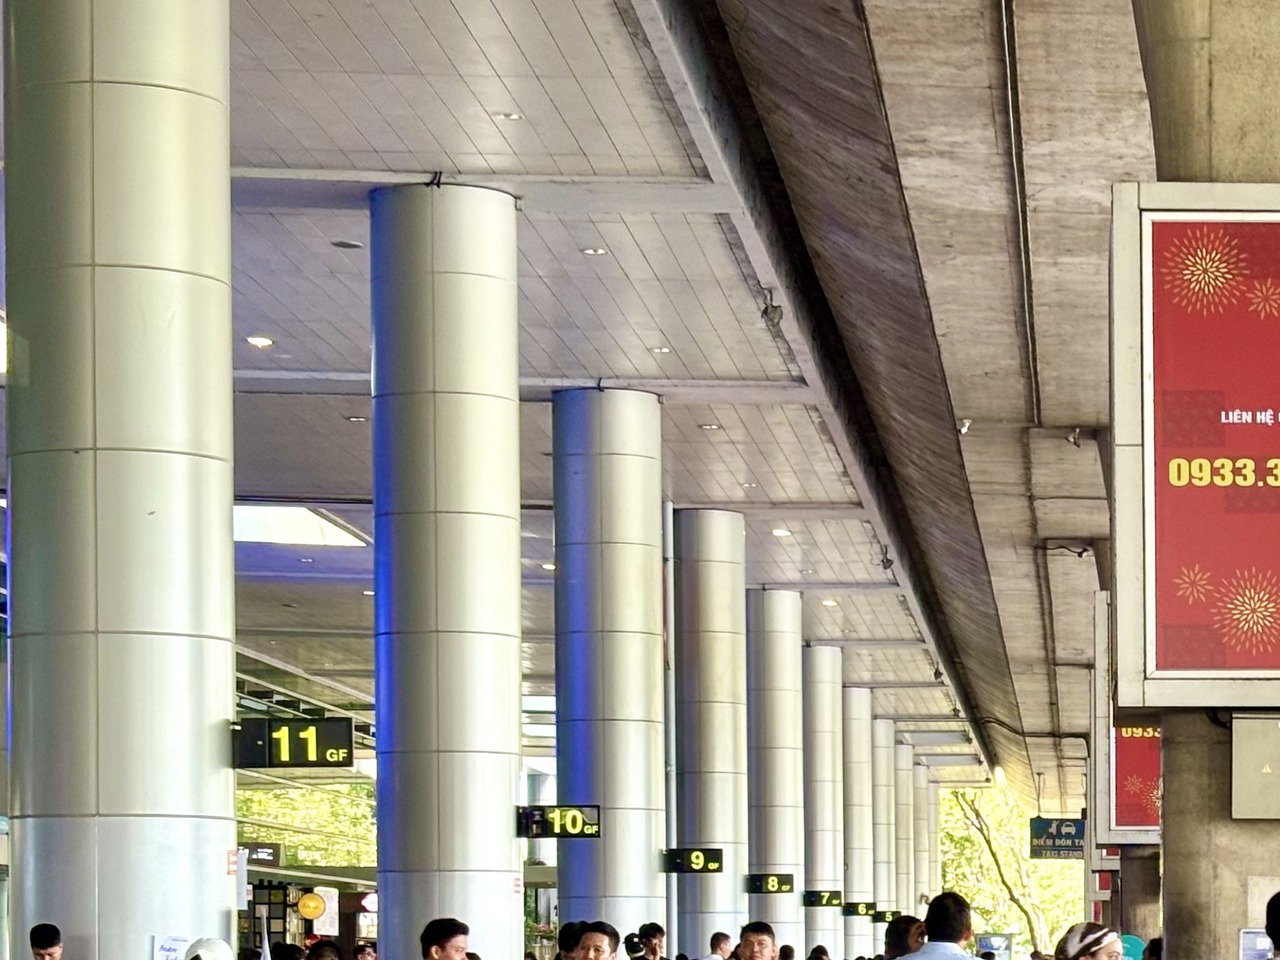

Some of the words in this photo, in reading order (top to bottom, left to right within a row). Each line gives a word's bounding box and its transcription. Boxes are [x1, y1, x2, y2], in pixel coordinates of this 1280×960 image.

[1221, 409, 1252, 424] LIÊN
[1256, 409, 1275, 426] HỆ
[272, 726, 318, 762] 11
[326, 749, 349, 762] GF
[549, 809, 583, 834] 10
[584, 825, 599, 834] GF
[690, 851, 705, 870] 9
[708, 862, 720, 870] GF
[767, 876, 779, 892] 8
[820, 892, 831, 905] 7
[857, 903, 867, 915] 6
[885, 911, 893, 922] 5
